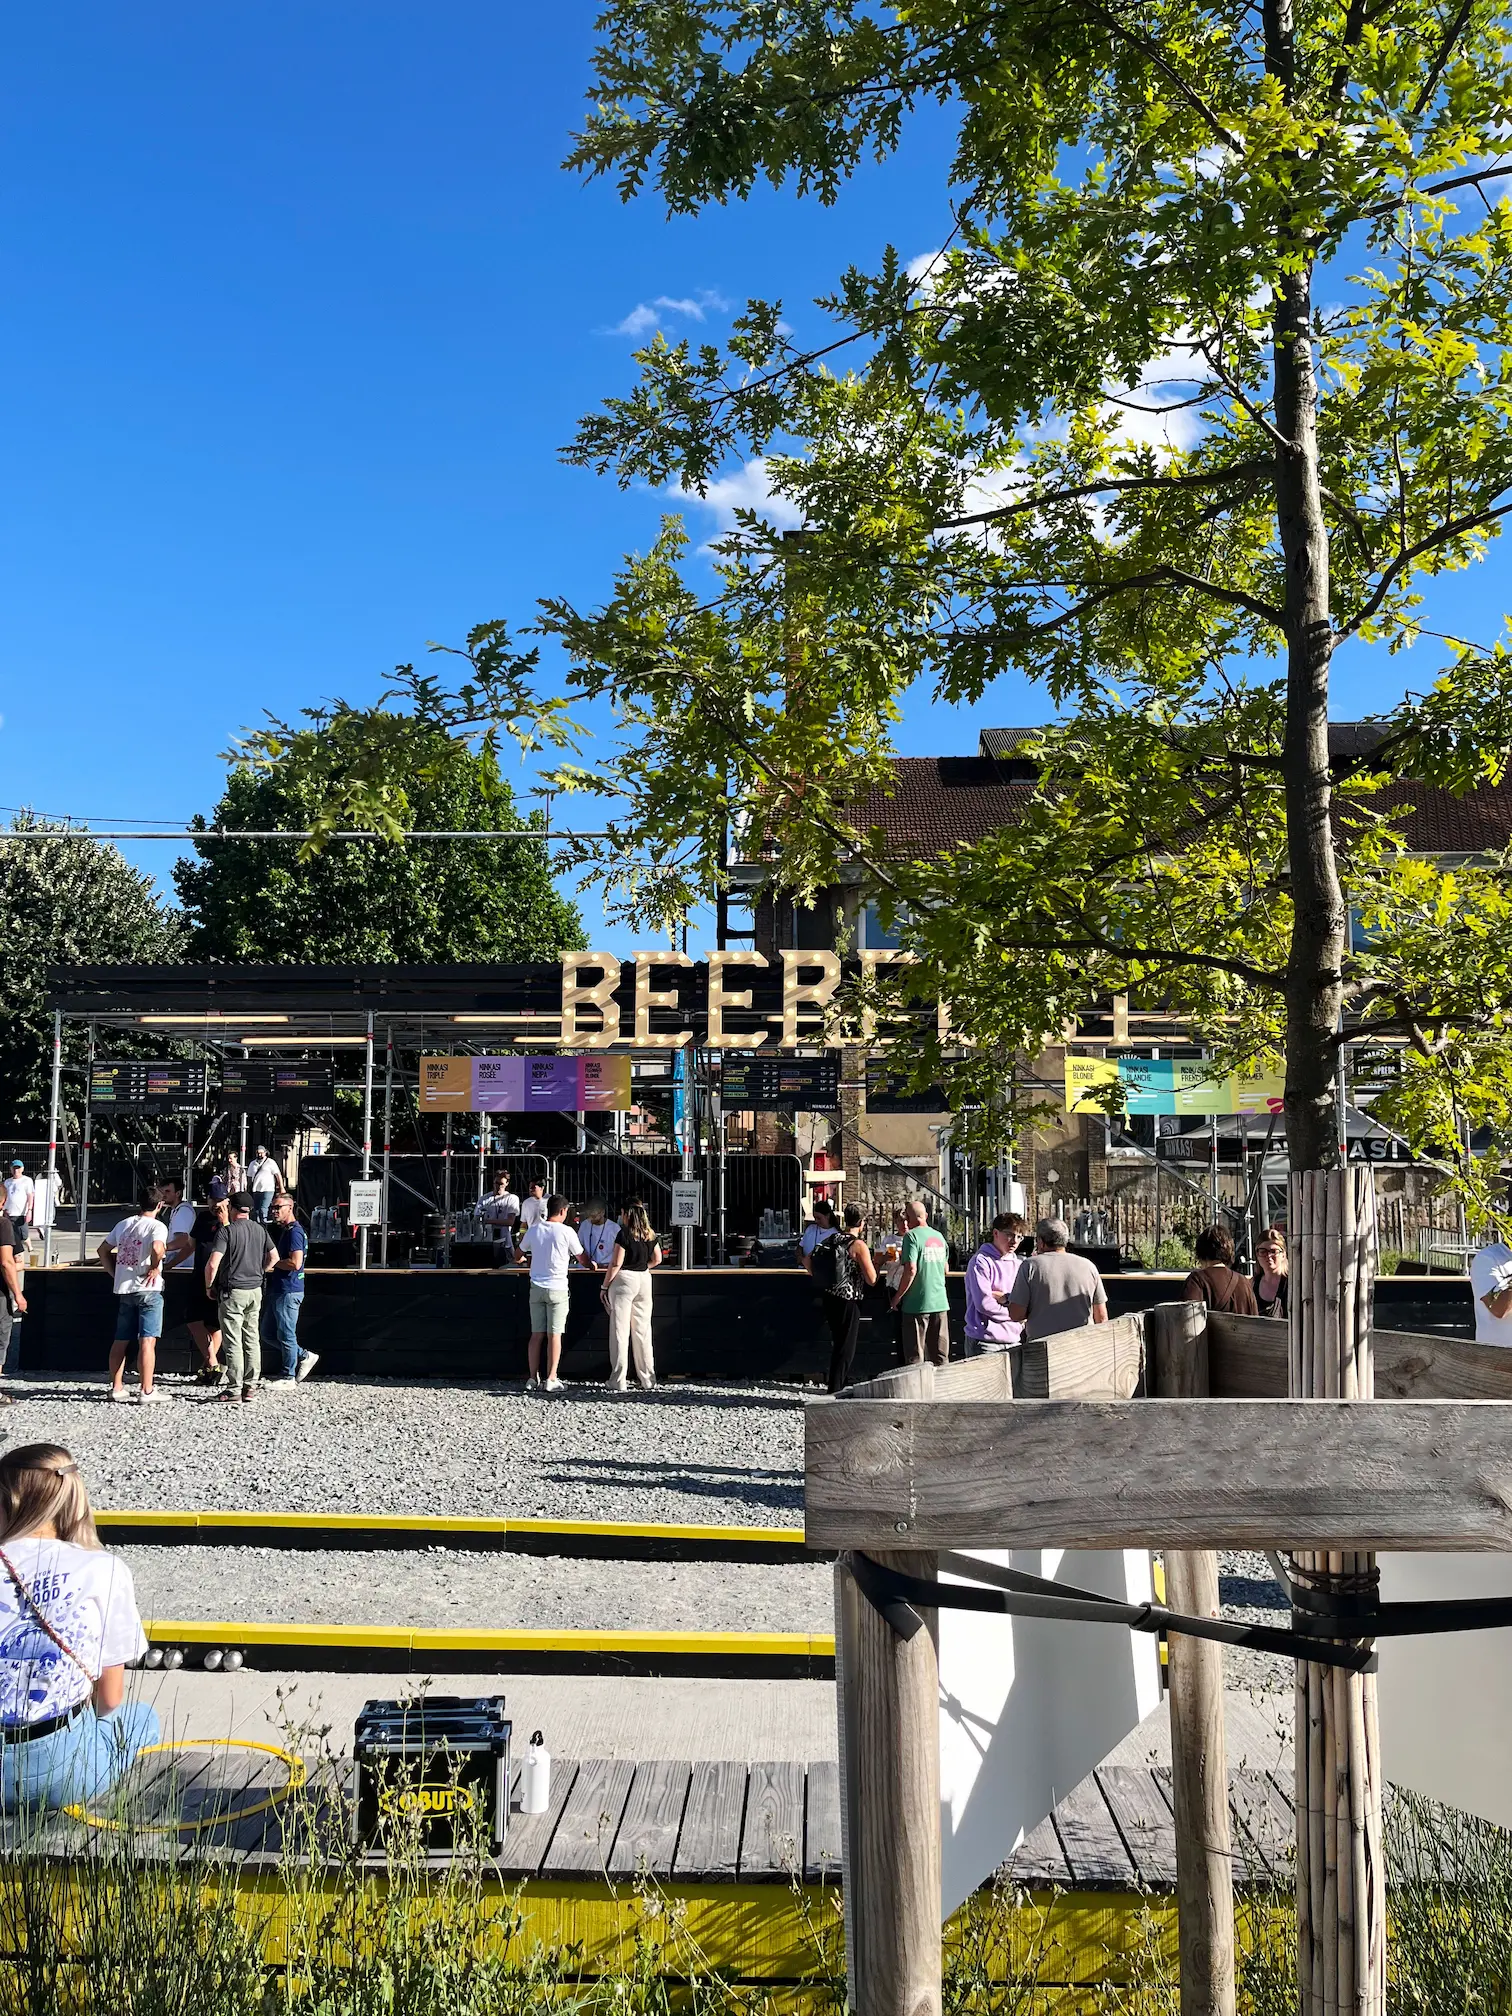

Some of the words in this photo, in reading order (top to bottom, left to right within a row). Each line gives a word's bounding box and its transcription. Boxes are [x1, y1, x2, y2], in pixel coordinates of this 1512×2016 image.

[427, 1063, 449, 1071] NINKASI
[479, 1063, 501, 1071] NINKASI
[532, 1062, 554, 1070] NINKASI
[1125, 1065, 1149, 1073] NINKASI
[479, 1070, 497, 1079] ROSÉE
[532, 1071, 548, 1079] NEIPA
[1072, 1072, 1094, 1080] BLONDE
[1164, 1138, 1194, 1158] NINKASI
